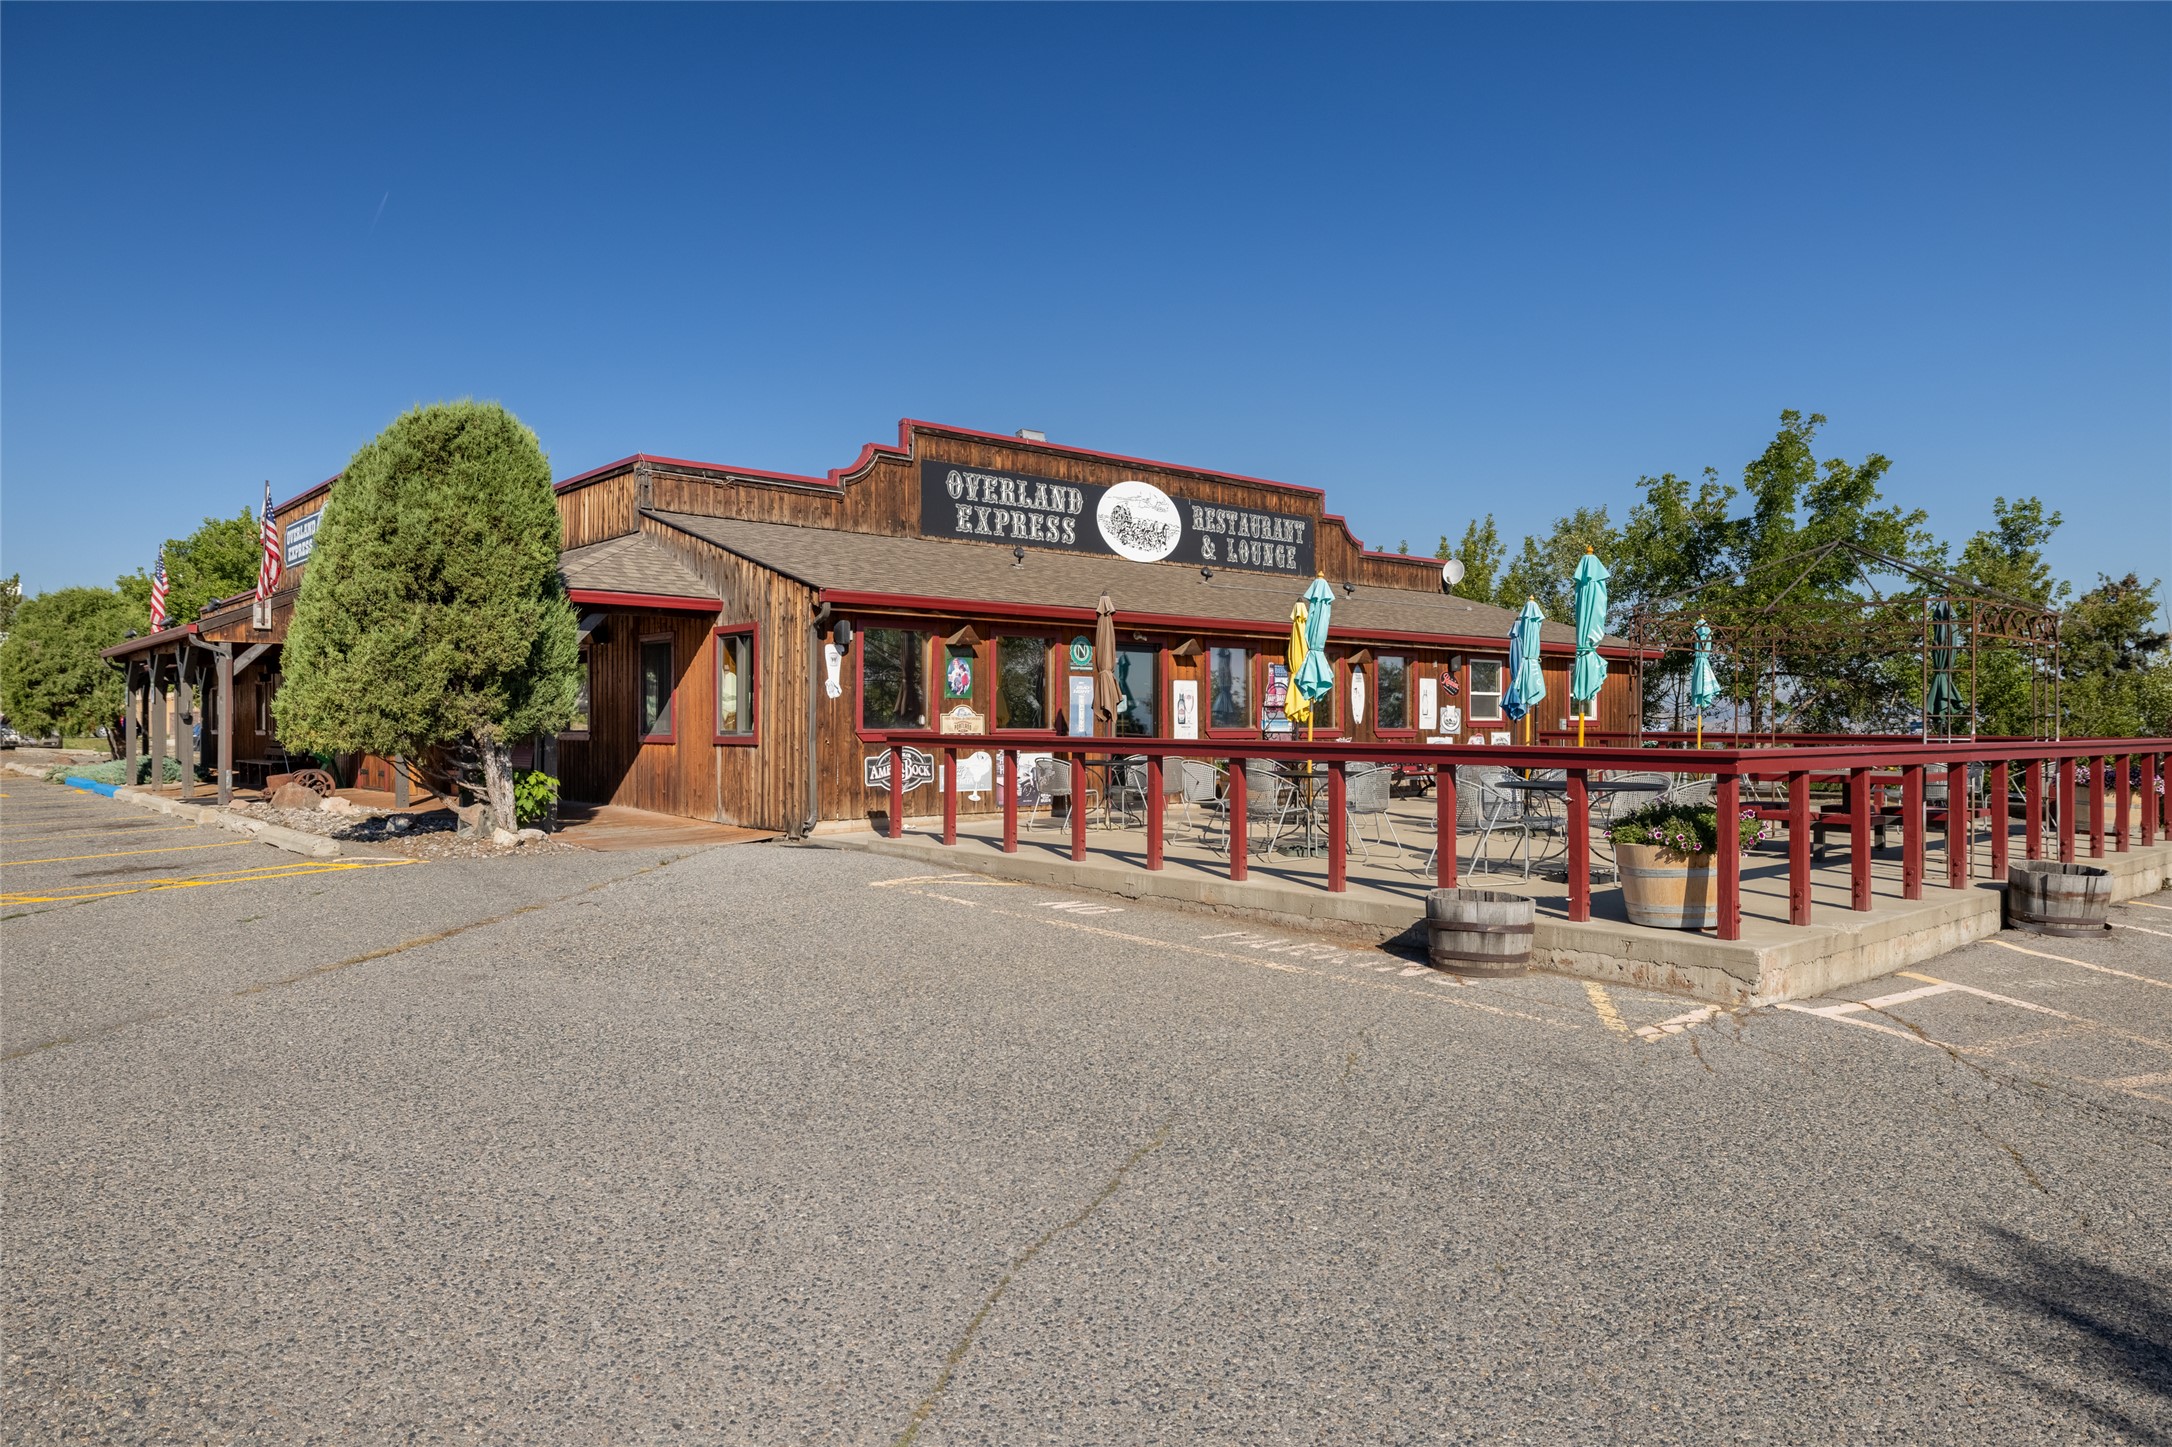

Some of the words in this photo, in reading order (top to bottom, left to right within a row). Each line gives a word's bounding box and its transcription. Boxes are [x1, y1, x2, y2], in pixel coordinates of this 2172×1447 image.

[945, 469, 1084, 515] OVERLAND
[287, 519, 316, 546] OVERLAND
[955, 503, 1076, 545] EXPRESS
[1191, 504, 1306, 545] RESTAURANT
[1201, 534, 1217, 561] &
[1226, 537, 1298, 570] LOUNGE
